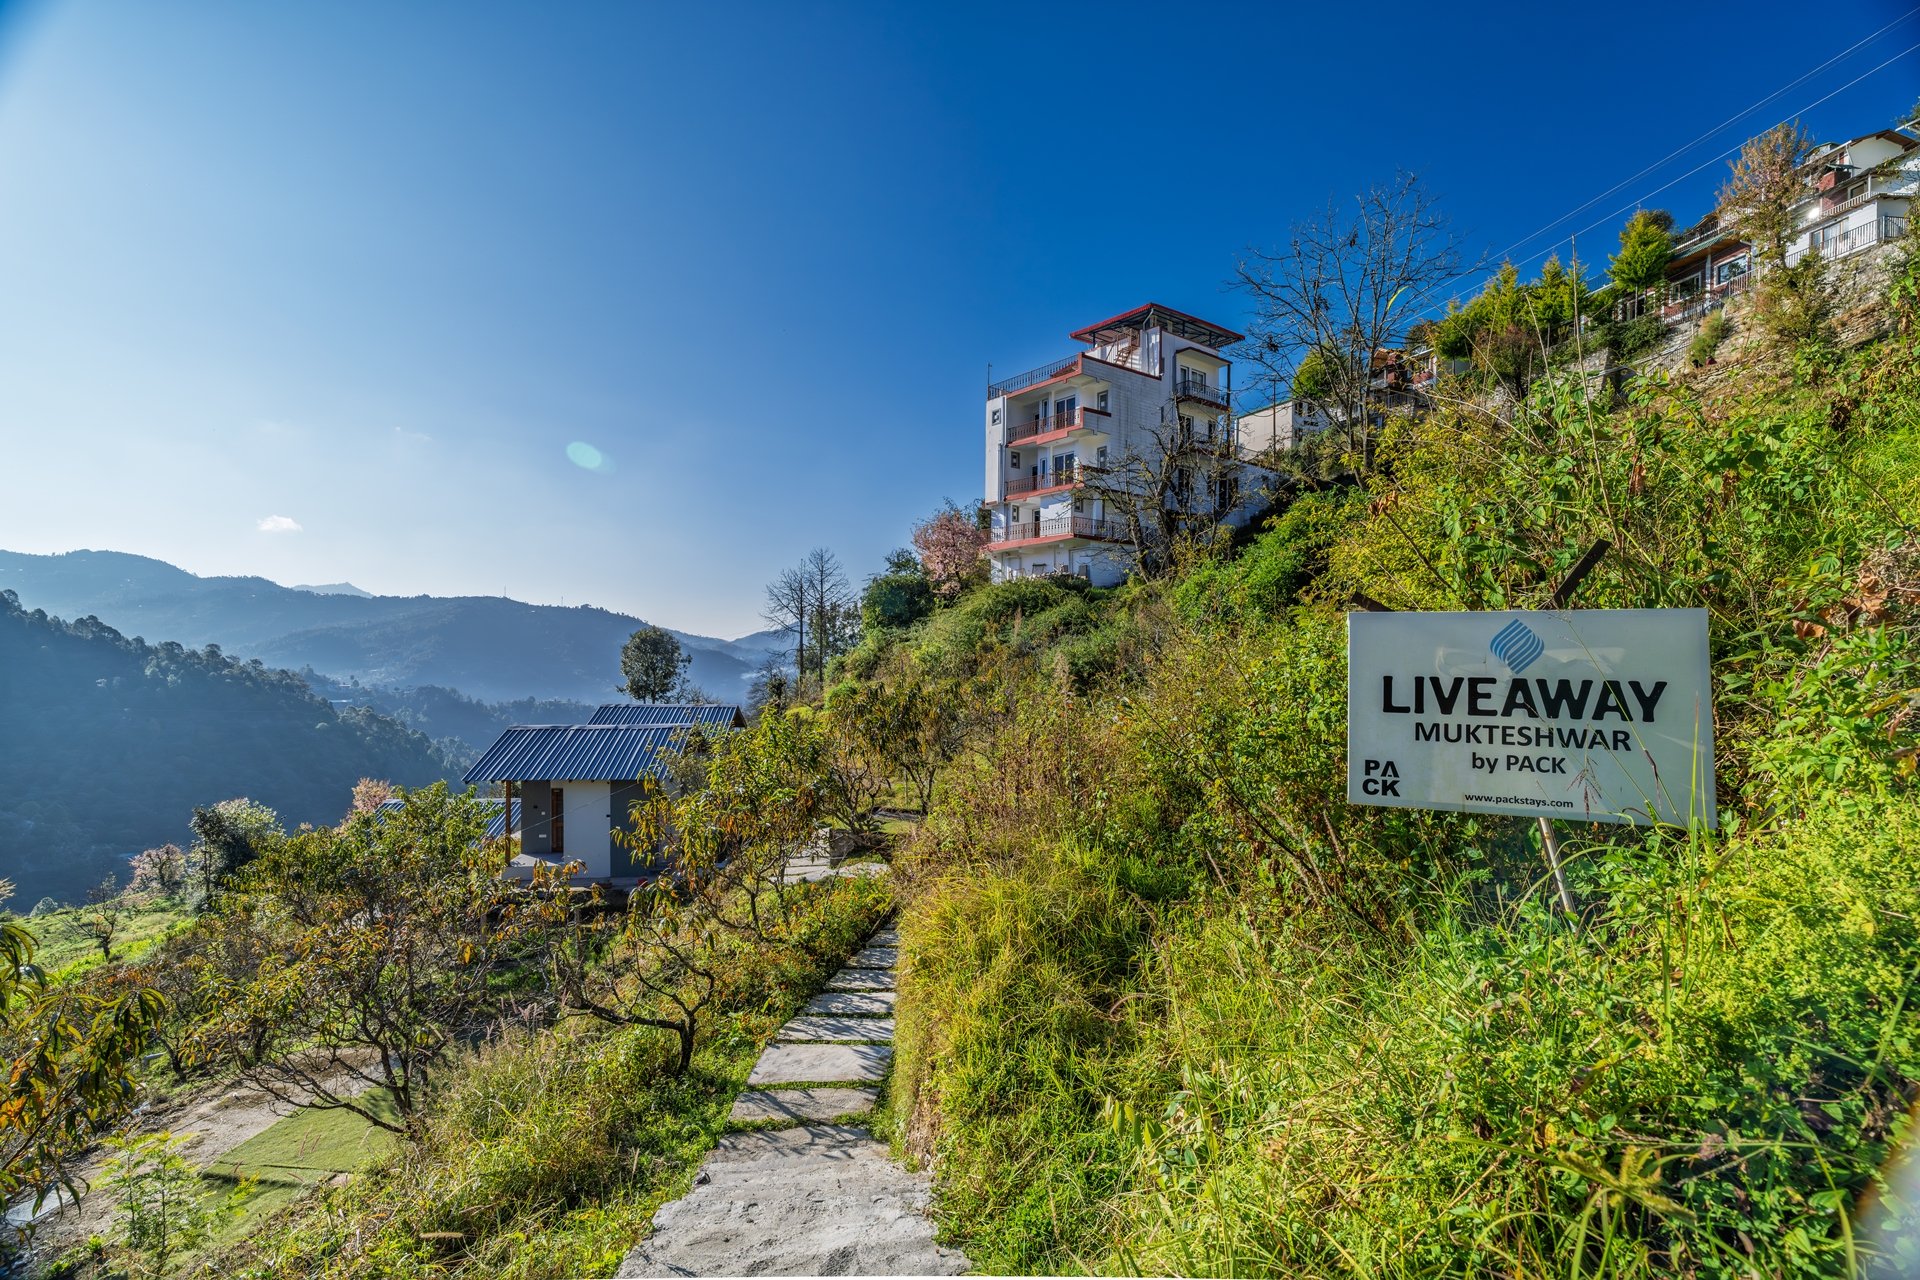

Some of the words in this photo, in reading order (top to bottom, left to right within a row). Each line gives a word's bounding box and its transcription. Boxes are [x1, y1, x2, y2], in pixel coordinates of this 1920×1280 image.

[1383, 675, 1668, 723] LIVEAWAY
[1415, 721, 1632, 752] MUKTESHWAR
[1472, 752, 1499, 774] by
[1506, 755, 1567, 775] PACK
[1464, 793, 1574, 809] www.packstays.com
